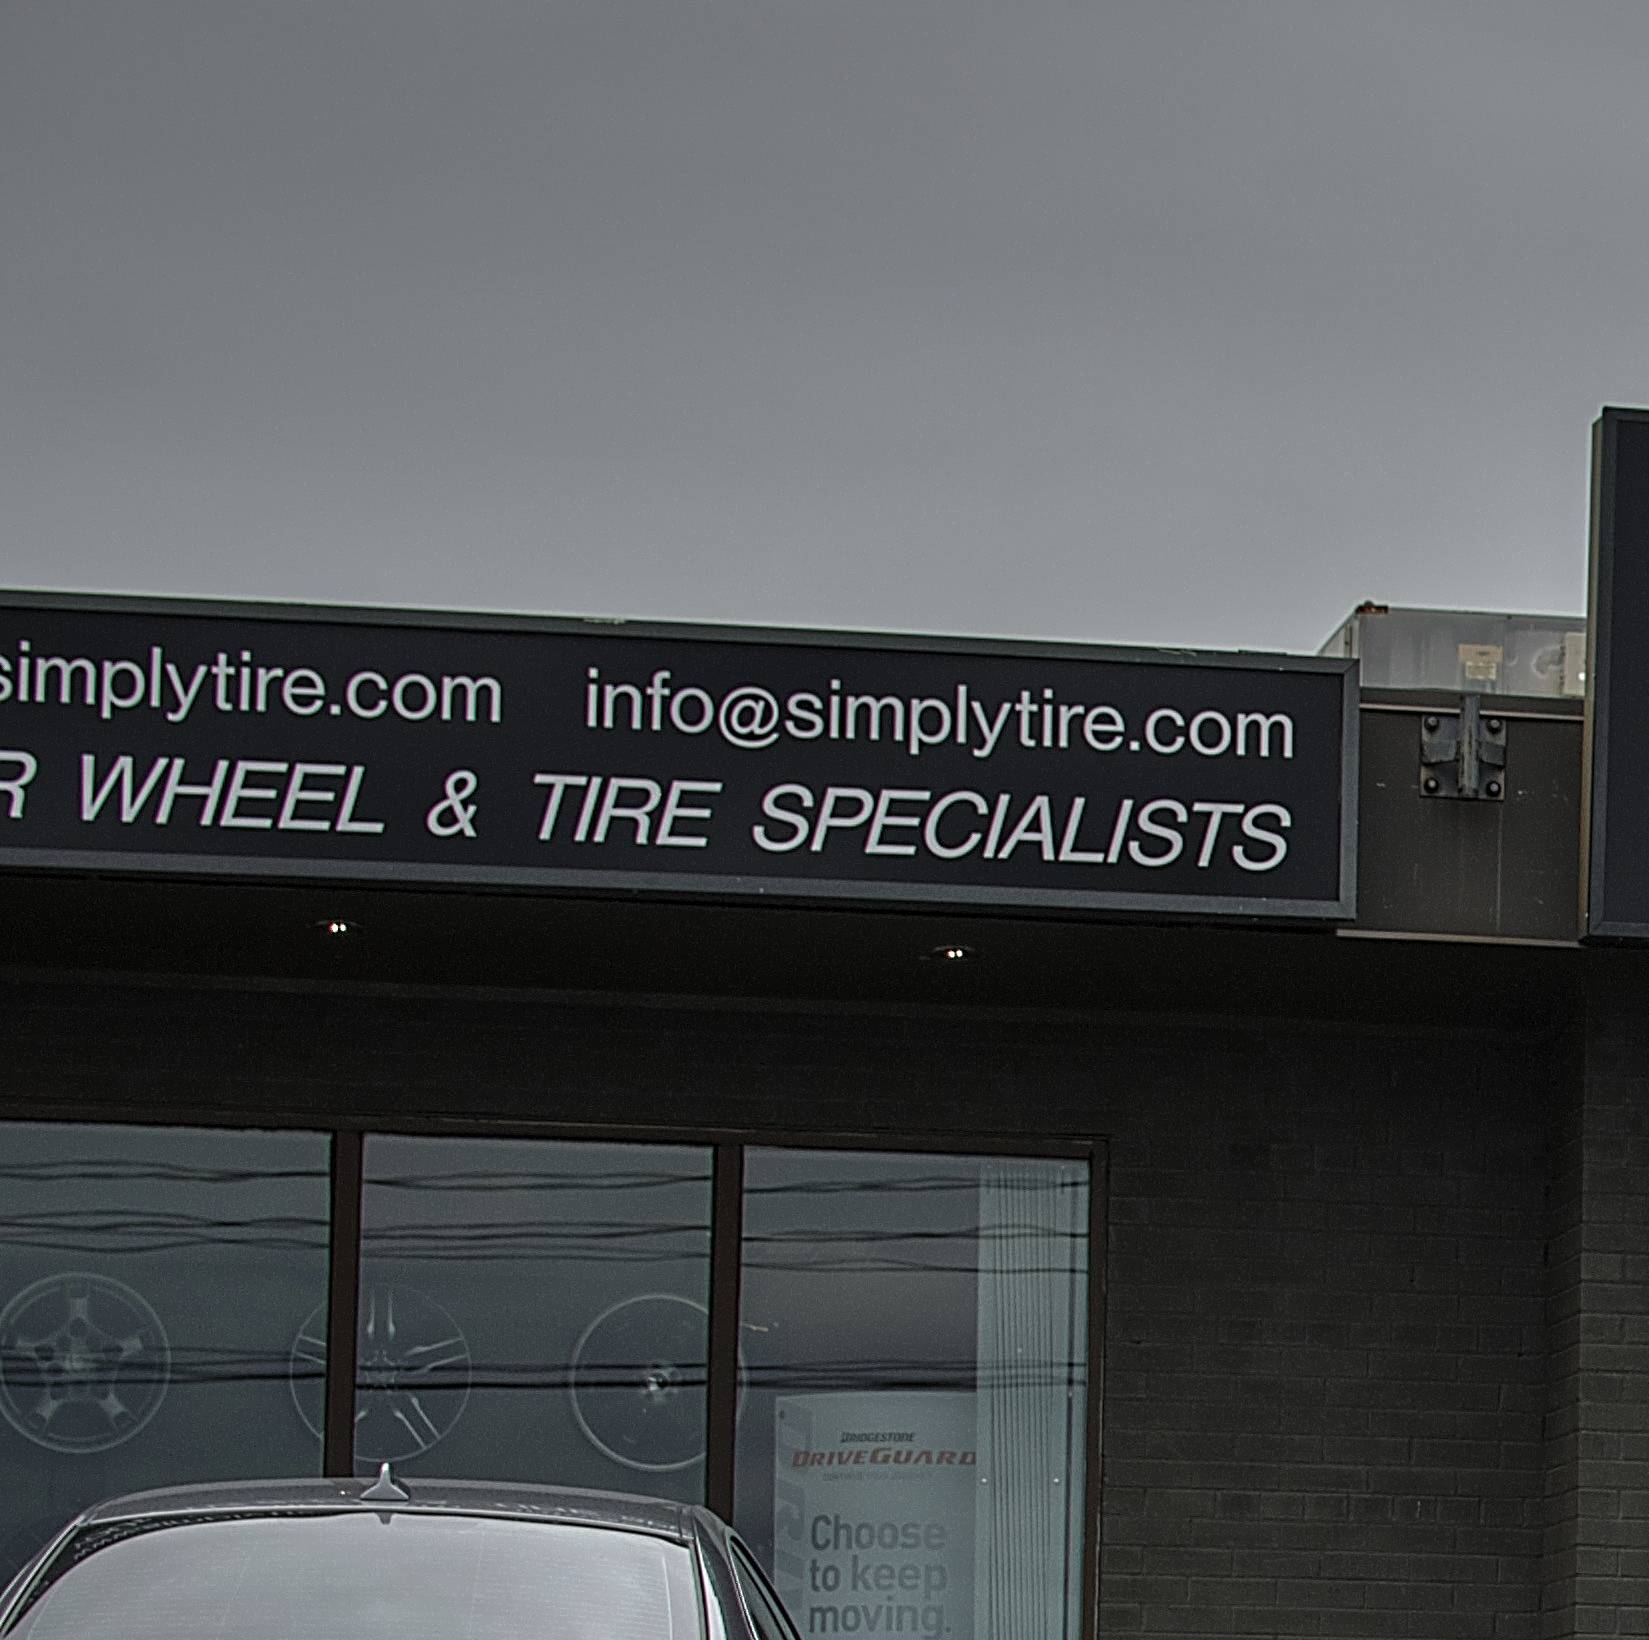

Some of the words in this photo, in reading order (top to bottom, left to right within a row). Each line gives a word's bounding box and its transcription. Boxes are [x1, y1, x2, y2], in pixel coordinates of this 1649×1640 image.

[585, 667, 1294, 758] info@simplytire.com
[80, 753, 386, 834] WHEEL
[426, 769, 478, 838] &
[533, 773, 723, 847] TIRE
[752, 783, 1292, 872] SPECIALISTS
[840, 1431, 916, 1443] BRIDGESTONE
[811, 1513, 947, 1551] Choose
[809, 1559, 840, 1592] to
[851, 1554, 948, 1599] keep
